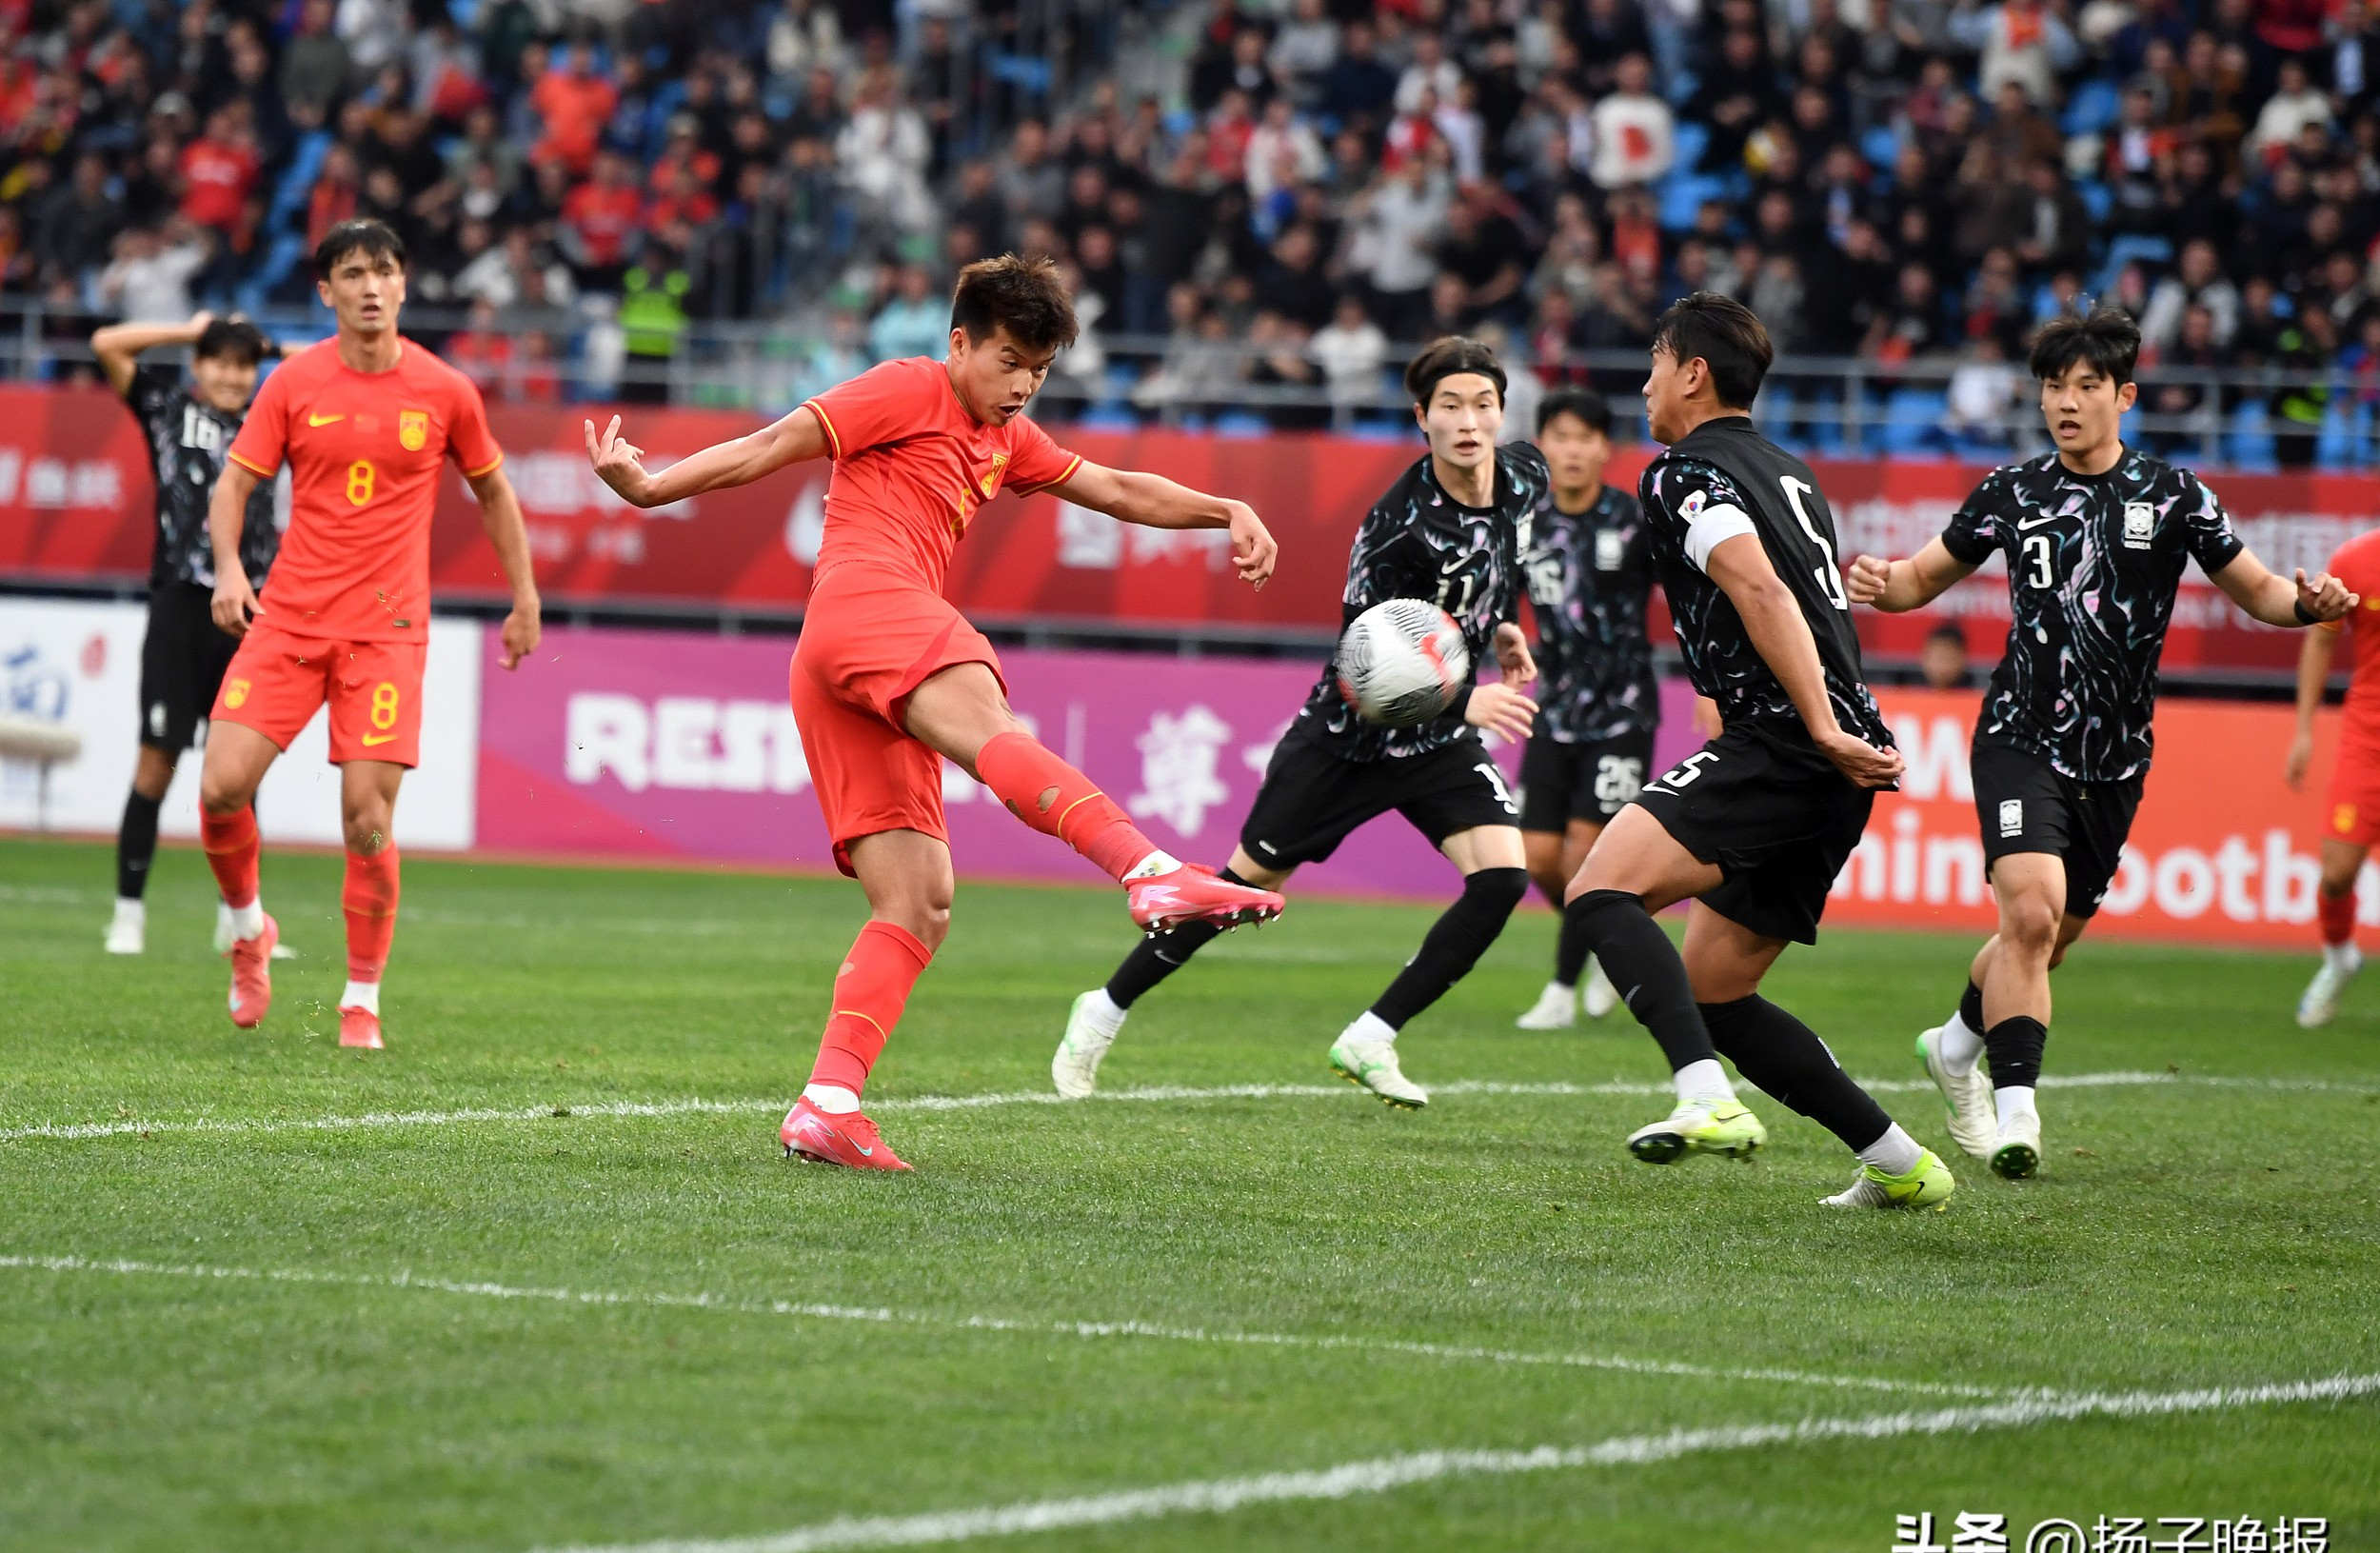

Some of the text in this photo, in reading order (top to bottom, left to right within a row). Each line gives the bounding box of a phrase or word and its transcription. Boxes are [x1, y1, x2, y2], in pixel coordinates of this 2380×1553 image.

[346, 459, 374, 506] 8
[1779, 475, 1848, 610] 5
[2023, 536, 2052, 588] 3
[1436, 574, 1469, 617] 11
[370, 683, 399, 729] 8
[1595, 755, 1642, 814] 26
[1662, 751, 1719, 787] 5
[1830, 809, 1996, 905] hin
[2098, 828, 2380, 927] ootb
